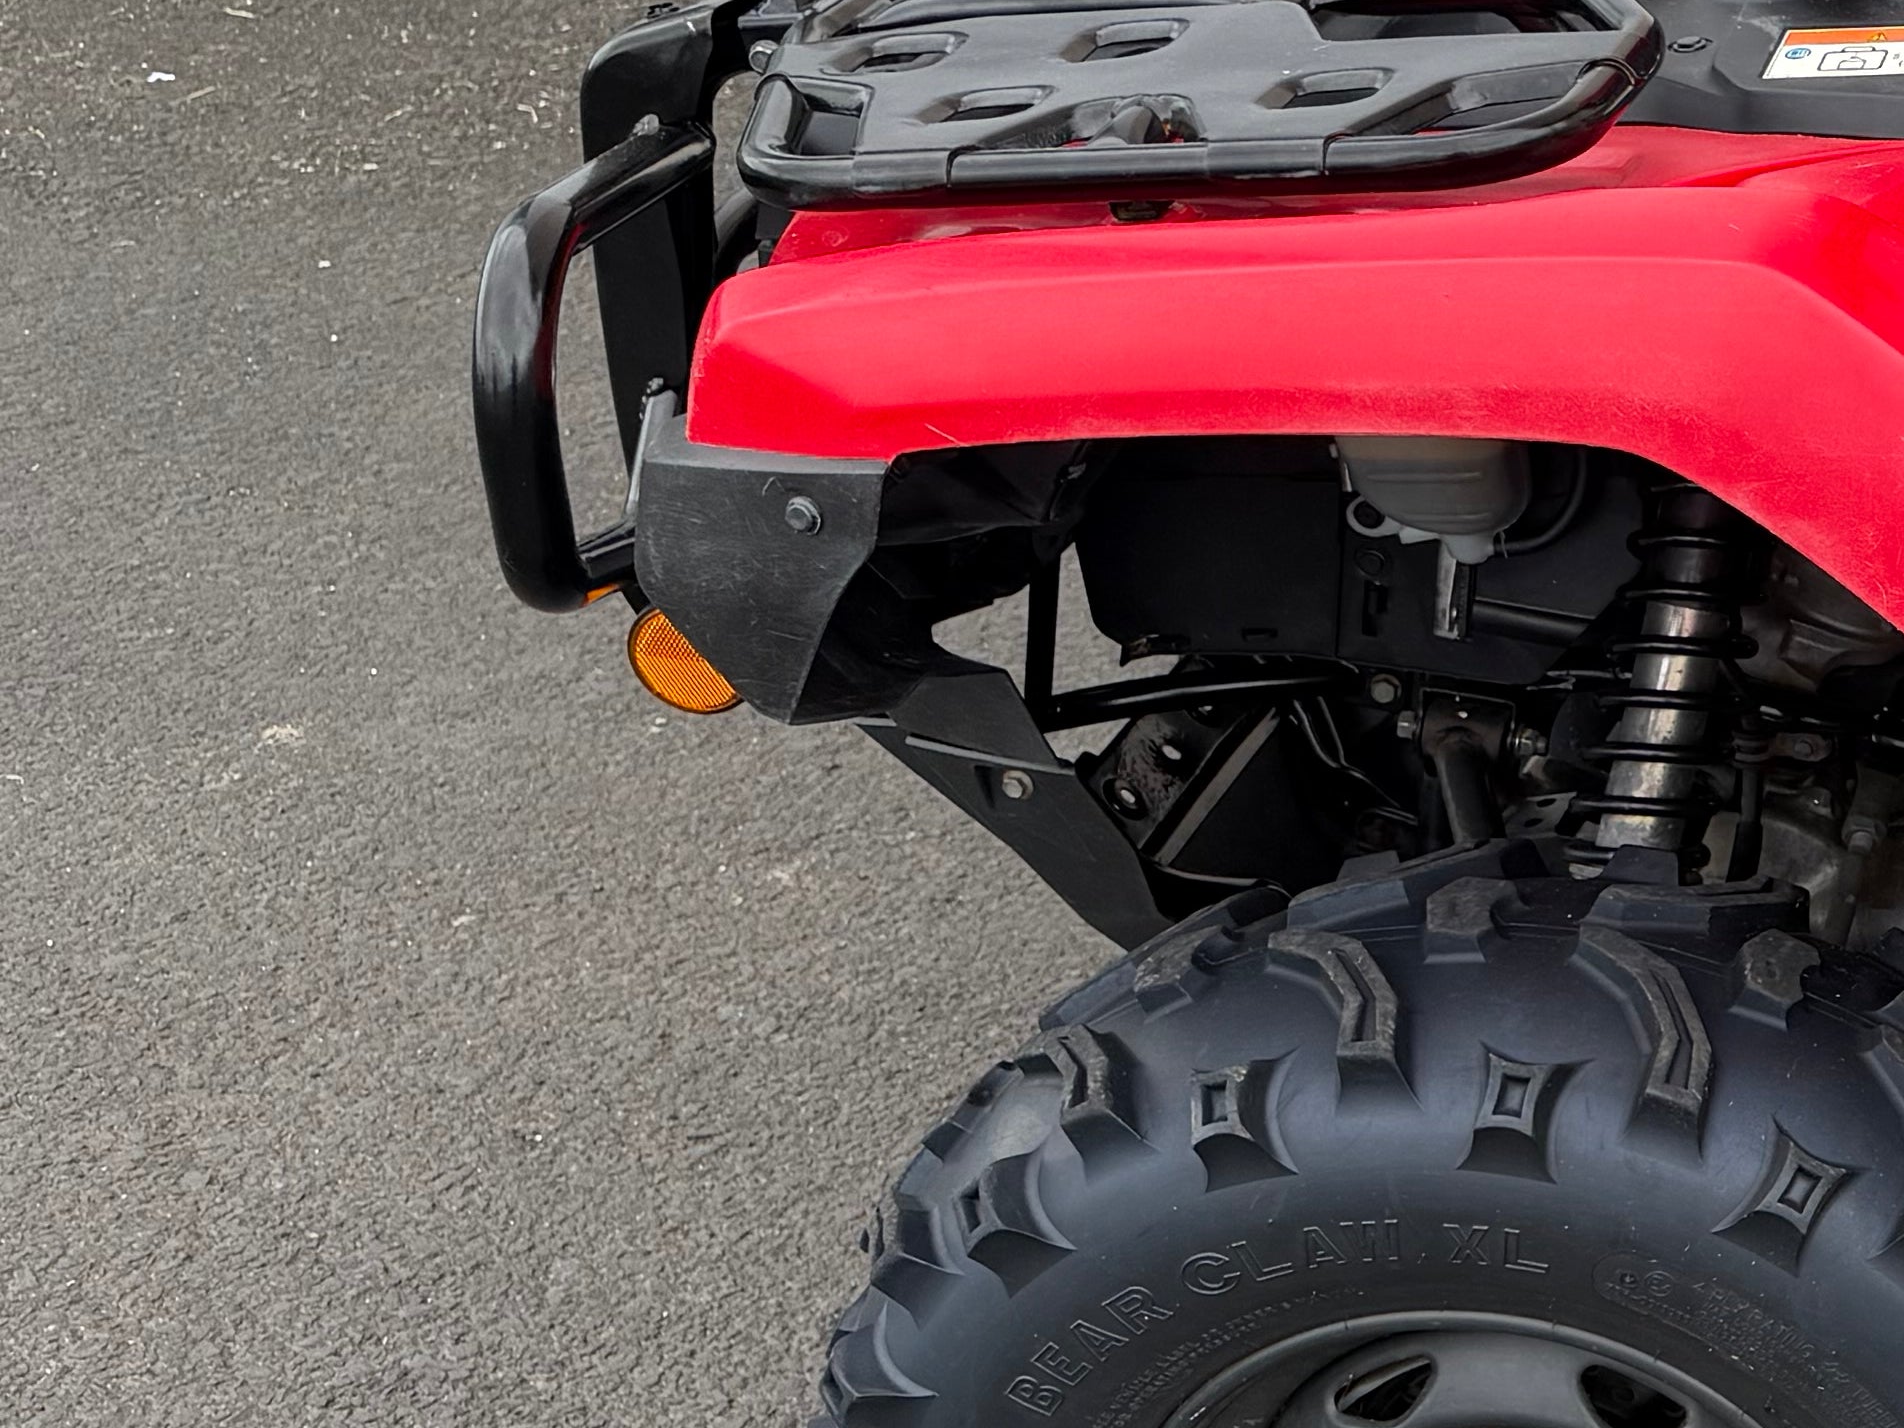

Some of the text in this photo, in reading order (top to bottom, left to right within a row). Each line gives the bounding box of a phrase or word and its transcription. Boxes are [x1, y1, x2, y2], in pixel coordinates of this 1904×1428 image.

[1004, 1286, 1174, 1416] BEAR
[1181, 1219, 1399, 1295] CLAW
[1441, 1222, 1549, 1273] XL
